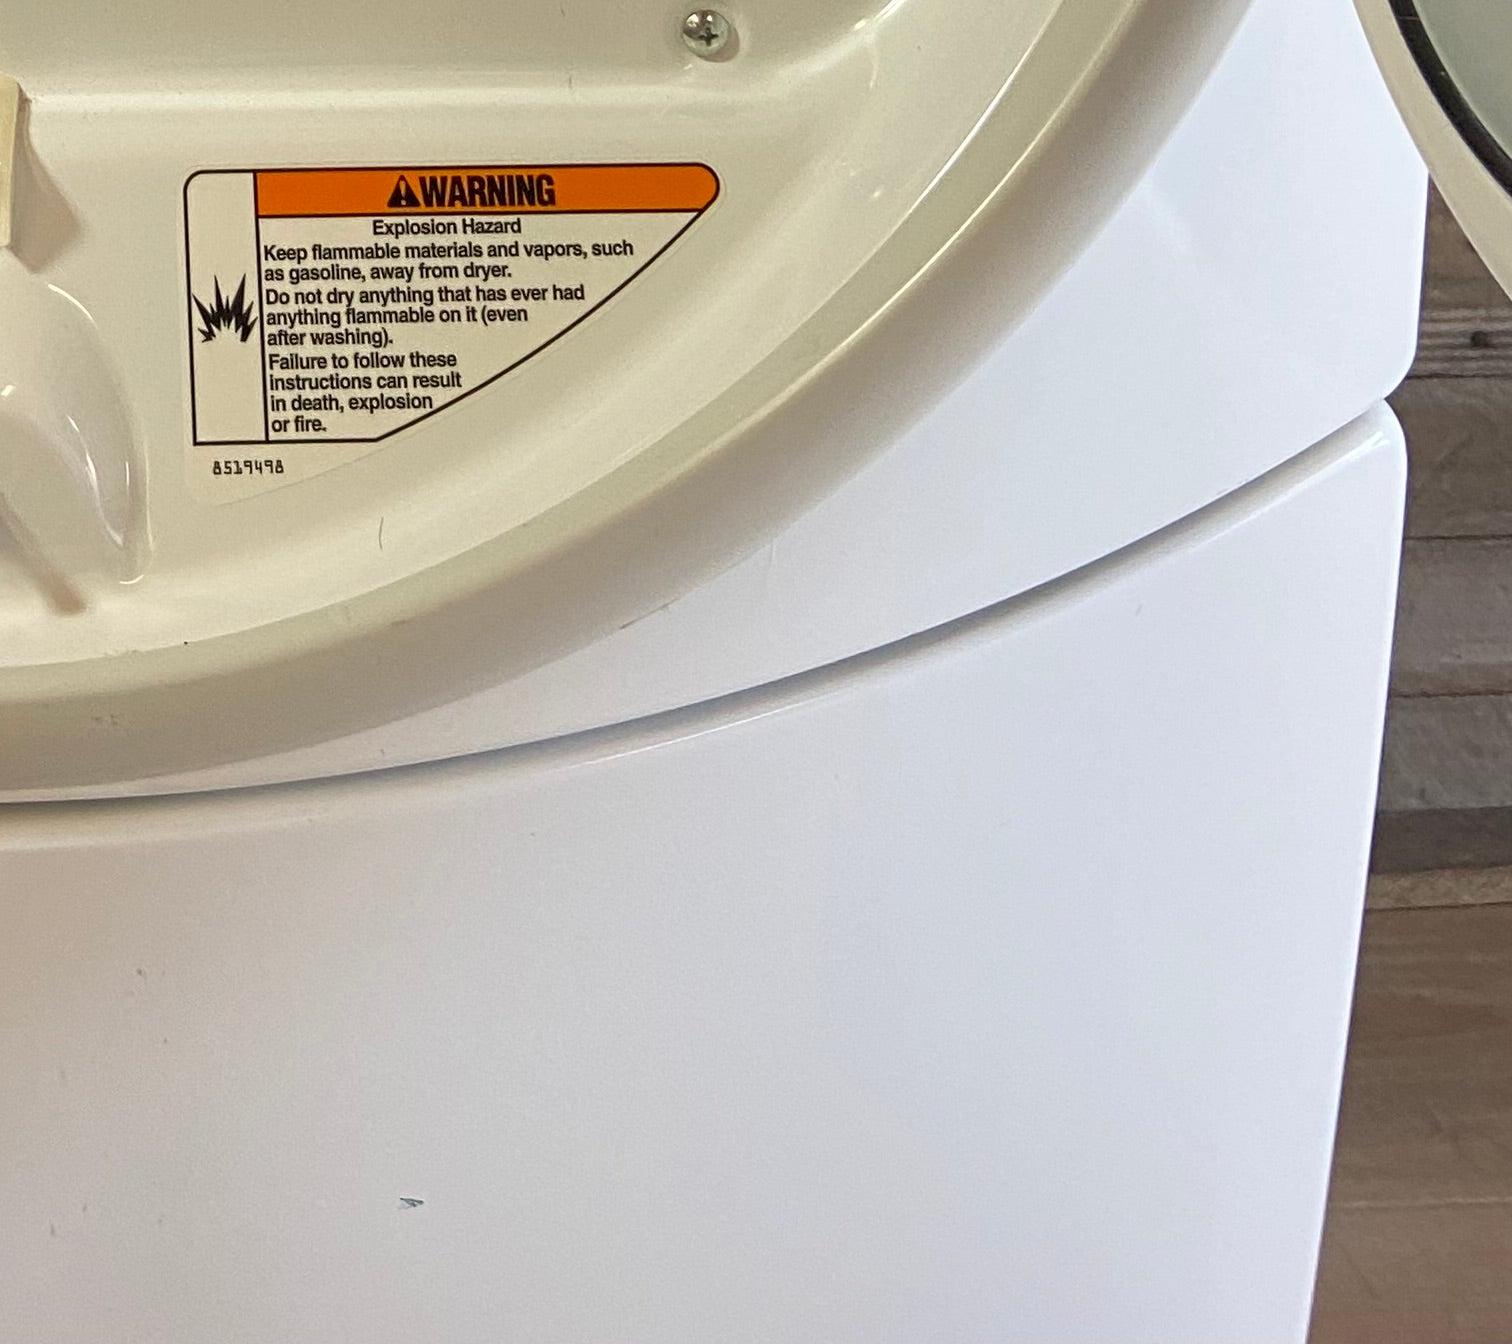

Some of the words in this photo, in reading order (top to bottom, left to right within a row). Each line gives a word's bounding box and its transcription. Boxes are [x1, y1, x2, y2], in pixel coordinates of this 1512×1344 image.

[420, 175, 555, 207] WARNING
[373, 219, 457, 239] Explosion
[462, 218, 521, 234] Hazard
[264, 245, 307, 264] Keep
[312, 243, 400, 260] flammable
[405, 241, 483, 258] materials
[487, 241, 519, 257] and
[523, 244, 587, 261] vapors,
[592, 240, 633, 256] such
[265, 268, 284, 281] as
[289, 264, 366, 285] gasoline,
[370, 266, 414, 283] away
[418, 262, 459, 278] from
[463, 262, 511, 282] dryer.
[266, 289, 290, 305] Do
[295, 289, 323, 304] not
[327, 287, 355, 307] dry
[360, 286, 434, 307] anything
[437, 286, 472, 302] that
[476, 285, 507, 301] has
[511, 288, 548, 301] ever
[553, 284, 585, 300] had
[267, 308, 341, 329] anything
[345, 306, 434, 324] flammable
[439, 310, 461, 322] on
[466, 306, 477, 322] it
[481, 305, 528, 326] (even
[267, 329, 306, 346] after
[310, 327, 393, 348] washing).
[272, 420, 290, 432] or
[294, 415, 326, 432] fire.
[213, 460, 284, 475] 8519498
